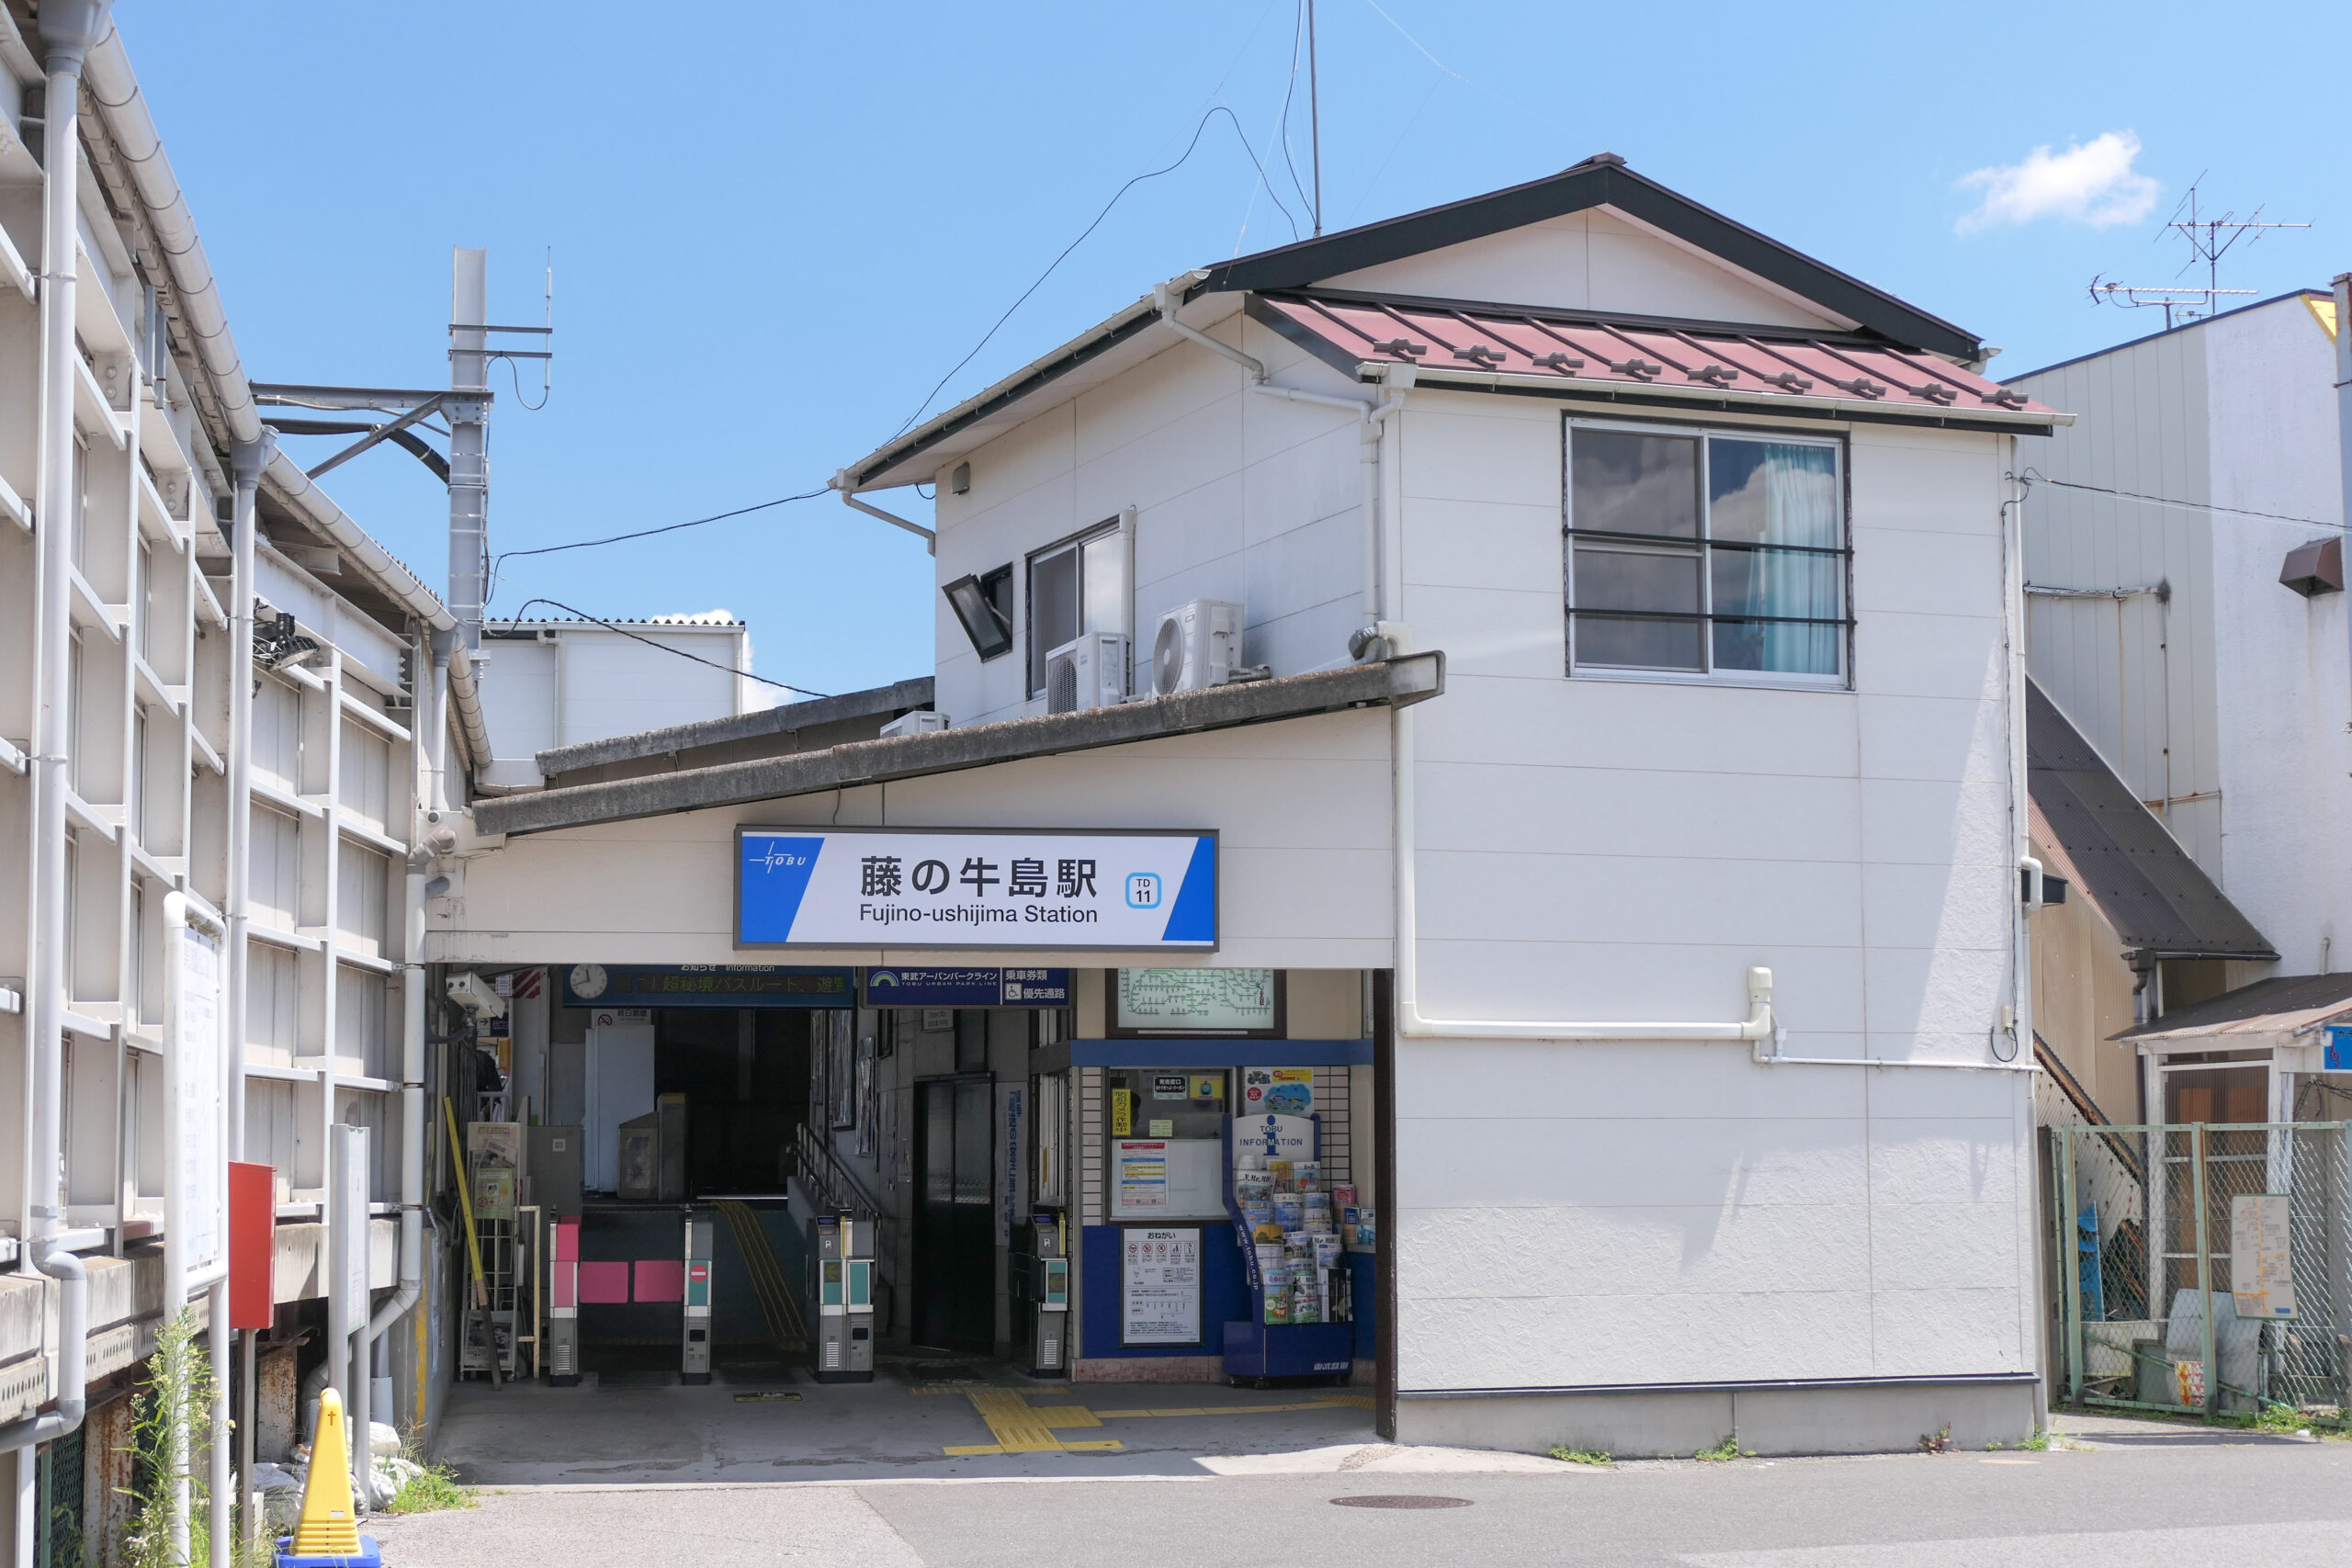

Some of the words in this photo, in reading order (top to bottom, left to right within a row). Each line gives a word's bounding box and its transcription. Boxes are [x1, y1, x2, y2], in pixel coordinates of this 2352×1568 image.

[861, 856, 1098, 898] 藤の牛島駅
[1136, 878, 1151, 887] TD
[1136, 890, 1150, 903] 11
[860, 903, 1018, 926] Fujino-ushijima
[1024, 904, 1098, 923] Station
[726, 964, 775, 973] Information
[901, 972, 998, 981] 東武アーバンパークライン
[1005, 969, 1048, 981] 乗車券類
[1023, 987, 1066, 999] 優先通路
[1239, 1138, 1304, 1146] INFORMATION
[1147, 1232, 1176, 1240] おねがい
[1238, 1224, 1260, 1291] www.tobu.co.jp
